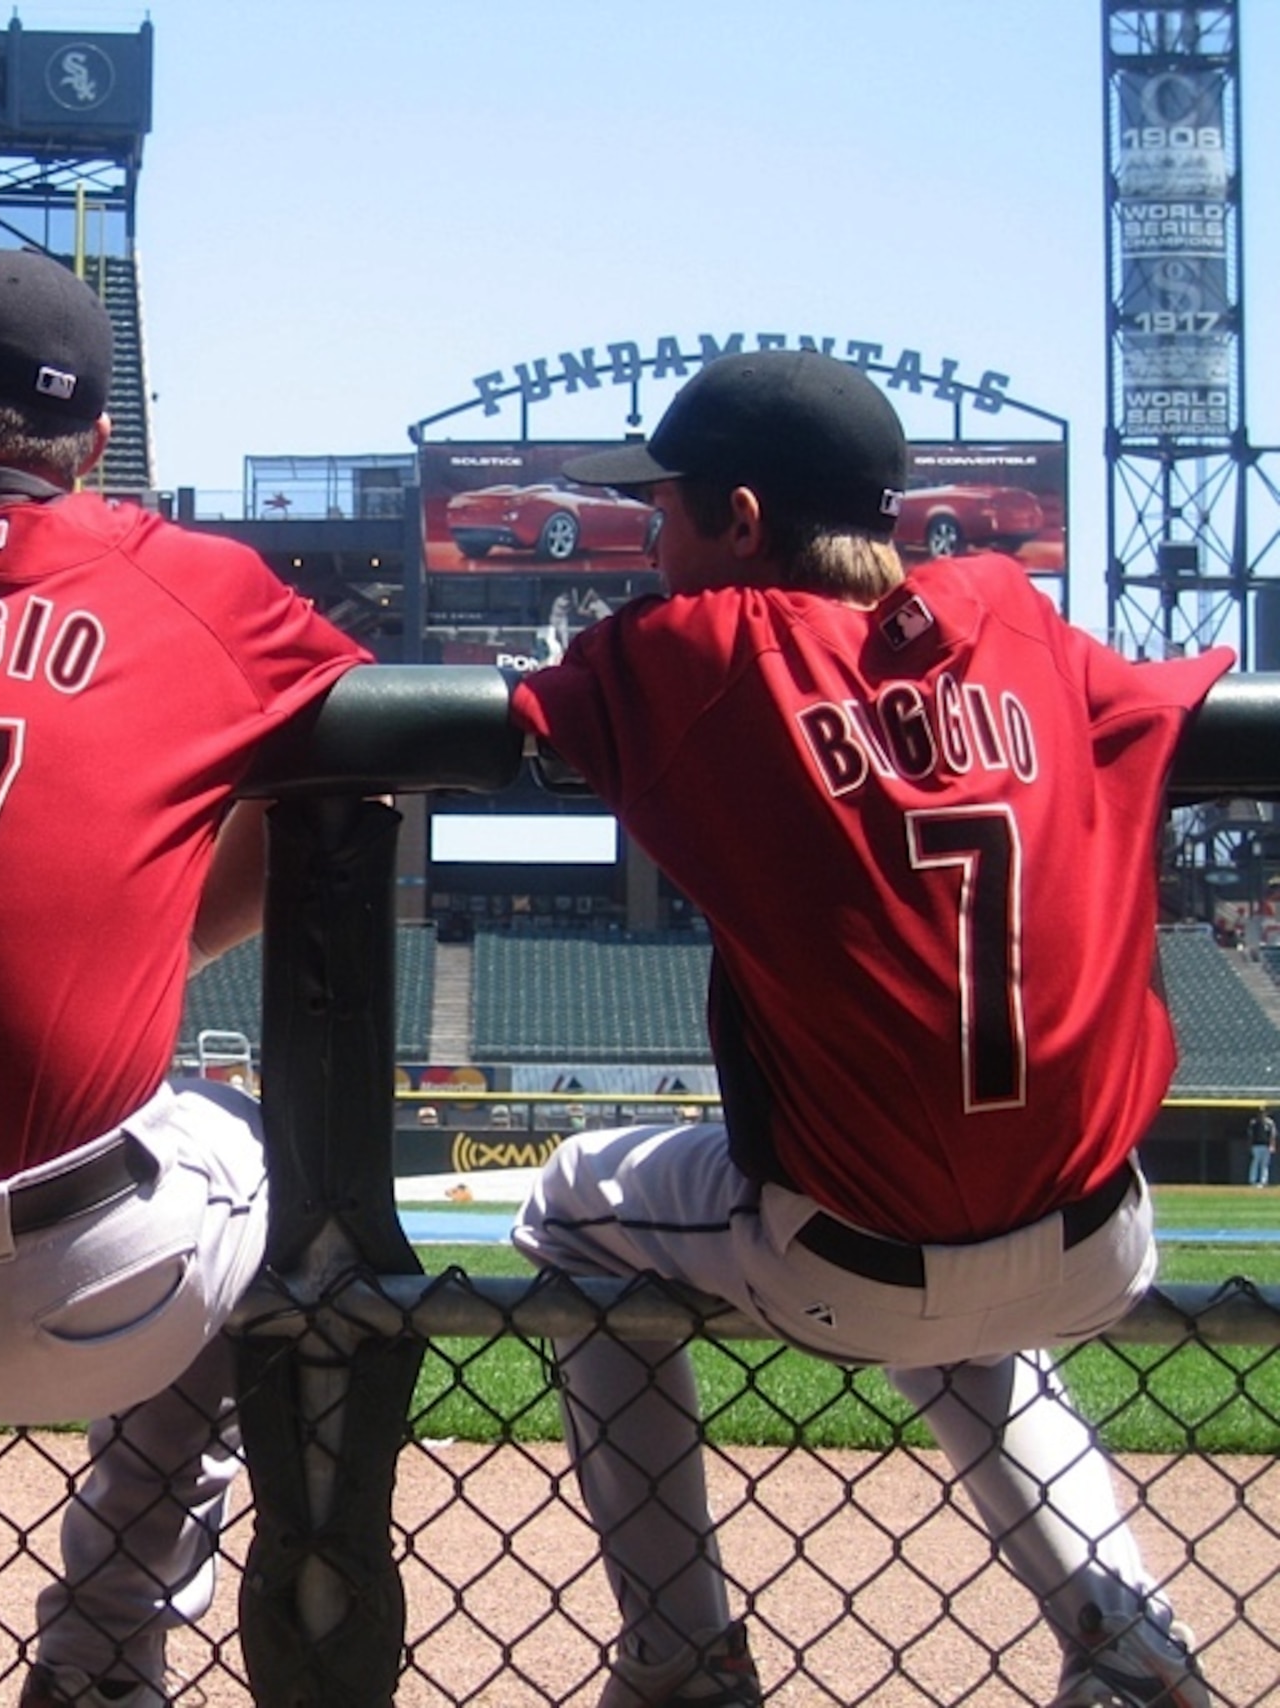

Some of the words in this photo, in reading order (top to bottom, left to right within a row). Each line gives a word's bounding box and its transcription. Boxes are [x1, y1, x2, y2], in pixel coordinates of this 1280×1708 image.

[1122, 126, 1222, 149] 1906
[1123, 203, 1224, 219] WORLD
[1123, 220, 1224, 237] SERIES
[1134, 311, 1220, 333] 1917
[1126, 391, 1227, 407] WORLD
[1126, 408, 1227, 424] SERIES
[797, 672, 1038, 797] BIGGIO
[904, 802, 1026, 1114] 7
